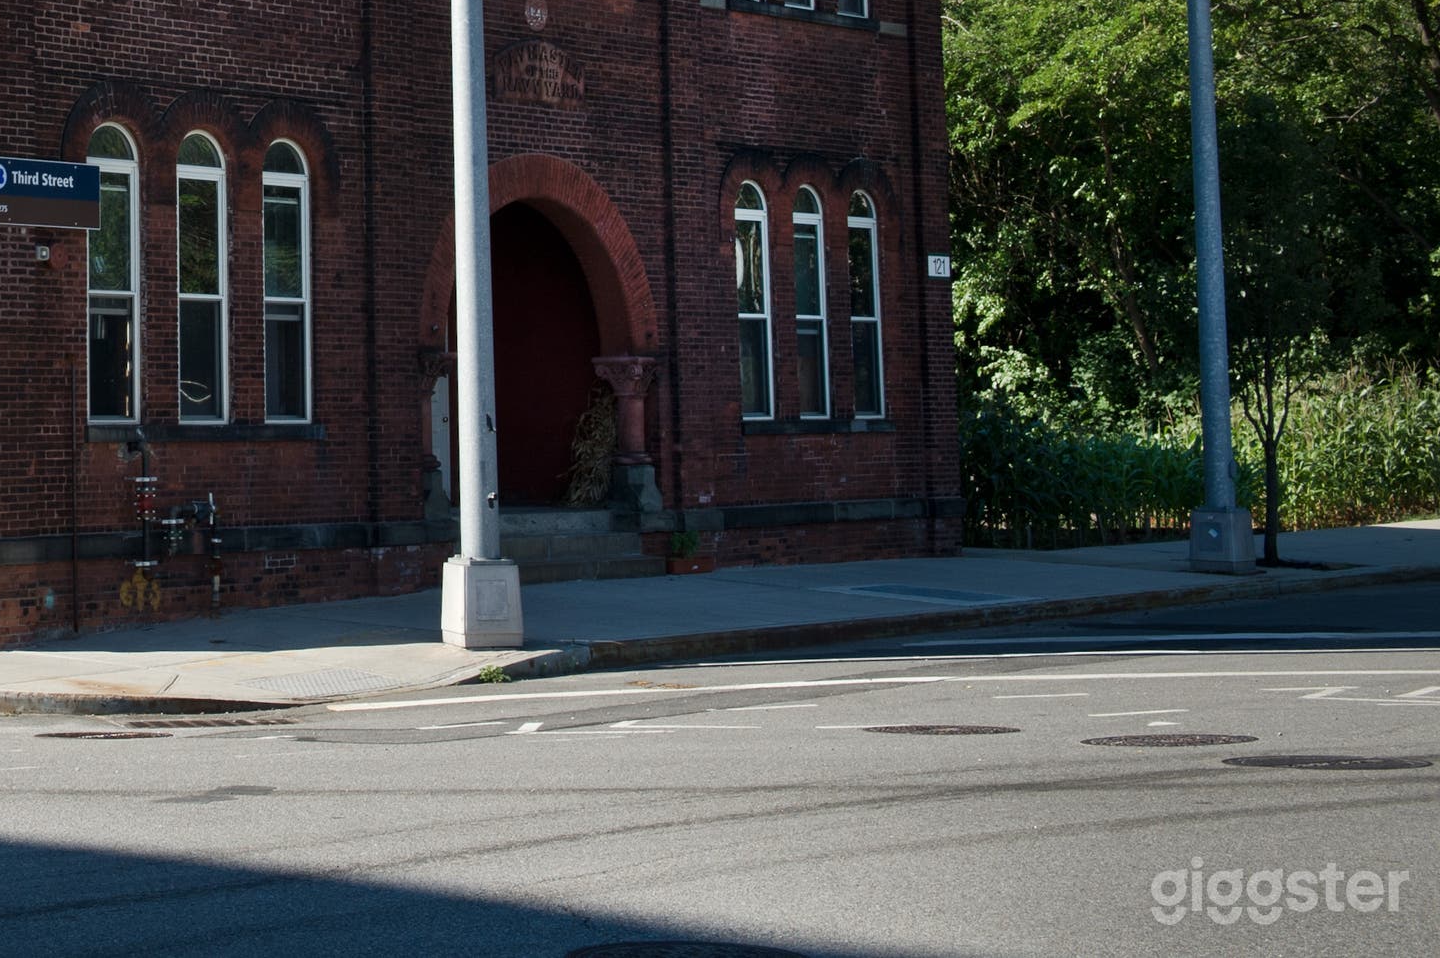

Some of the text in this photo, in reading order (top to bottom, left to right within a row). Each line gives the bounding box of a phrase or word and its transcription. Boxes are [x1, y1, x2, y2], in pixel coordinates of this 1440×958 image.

[12, 170, 39, 185] Third
[42, 173, 74, 188] Street
[933, 257, 945, 274] 121
